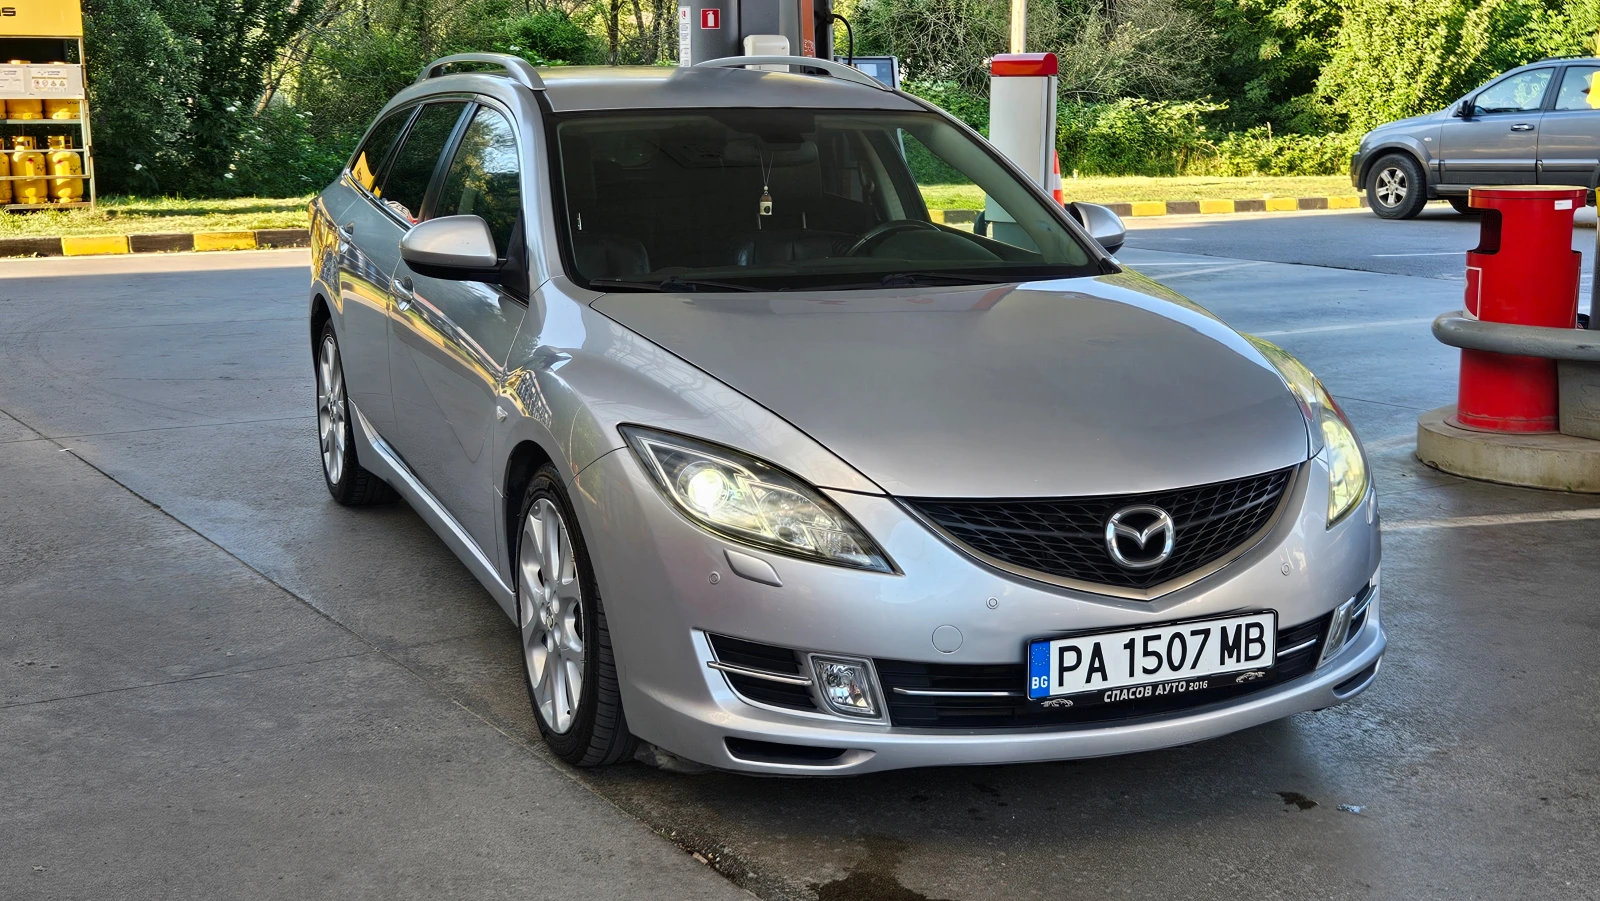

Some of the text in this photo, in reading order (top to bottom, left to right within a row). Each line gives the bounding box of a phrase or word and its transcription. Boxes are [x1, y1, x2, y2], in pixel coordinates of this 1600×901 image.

[1058, 622, 1266, 687] PA 1507 MB
[1031, 676, 1048, 689] BG
[1104, 680, 1208, 703] СПАСОВ АУТО 2016
